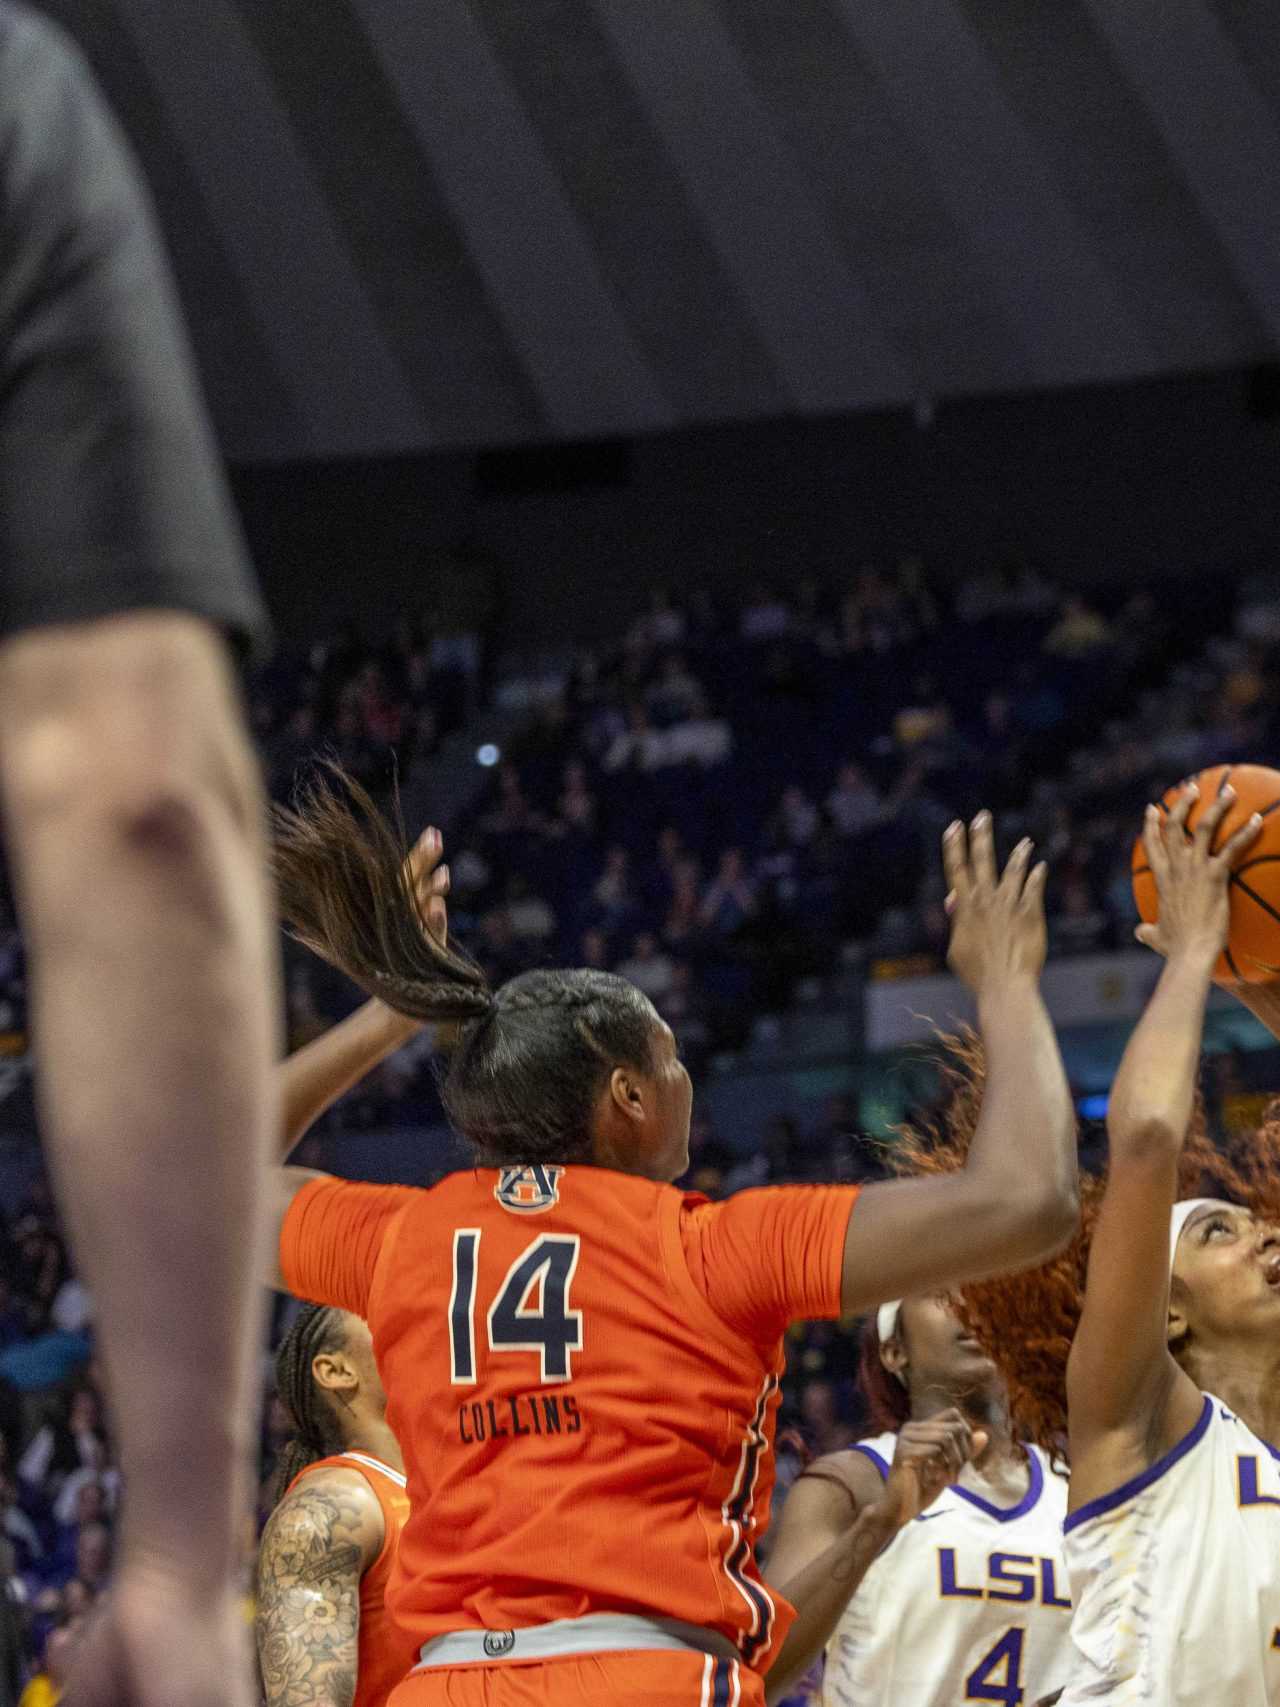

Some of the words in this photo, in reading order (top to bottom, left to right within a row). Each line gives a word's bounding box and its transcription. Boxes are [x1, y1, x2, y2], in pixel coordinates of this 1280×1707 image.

[449, 1228, 583, 1384] 14
[459, 1394, 581, 1444] COLLINS
[965, 1624, 1026, 1707] 4
